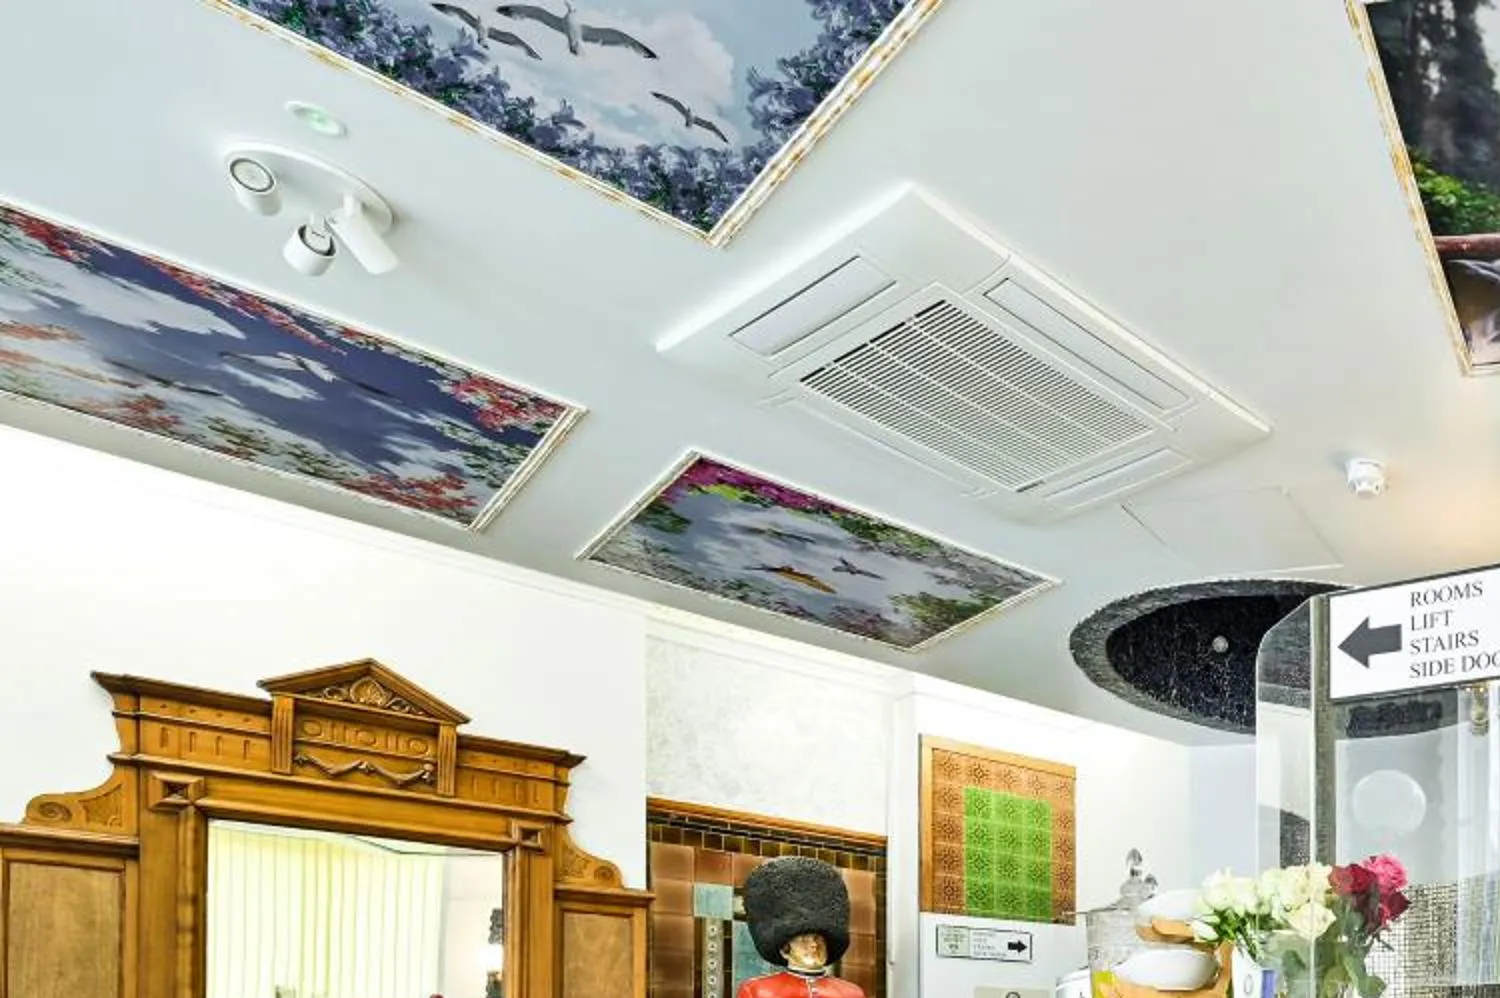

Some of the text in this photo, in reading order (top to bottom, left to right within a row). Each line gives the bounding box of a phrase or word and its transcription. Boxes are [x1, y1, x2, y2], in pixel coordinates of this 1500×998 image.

[1410, 581, 1483, 607] ROOMS
[1410, 609, 1454, 631] LIFT
[1409, 629, 1479, 655] STAIRS
[1409, 657, 1455, 678] SIDE
